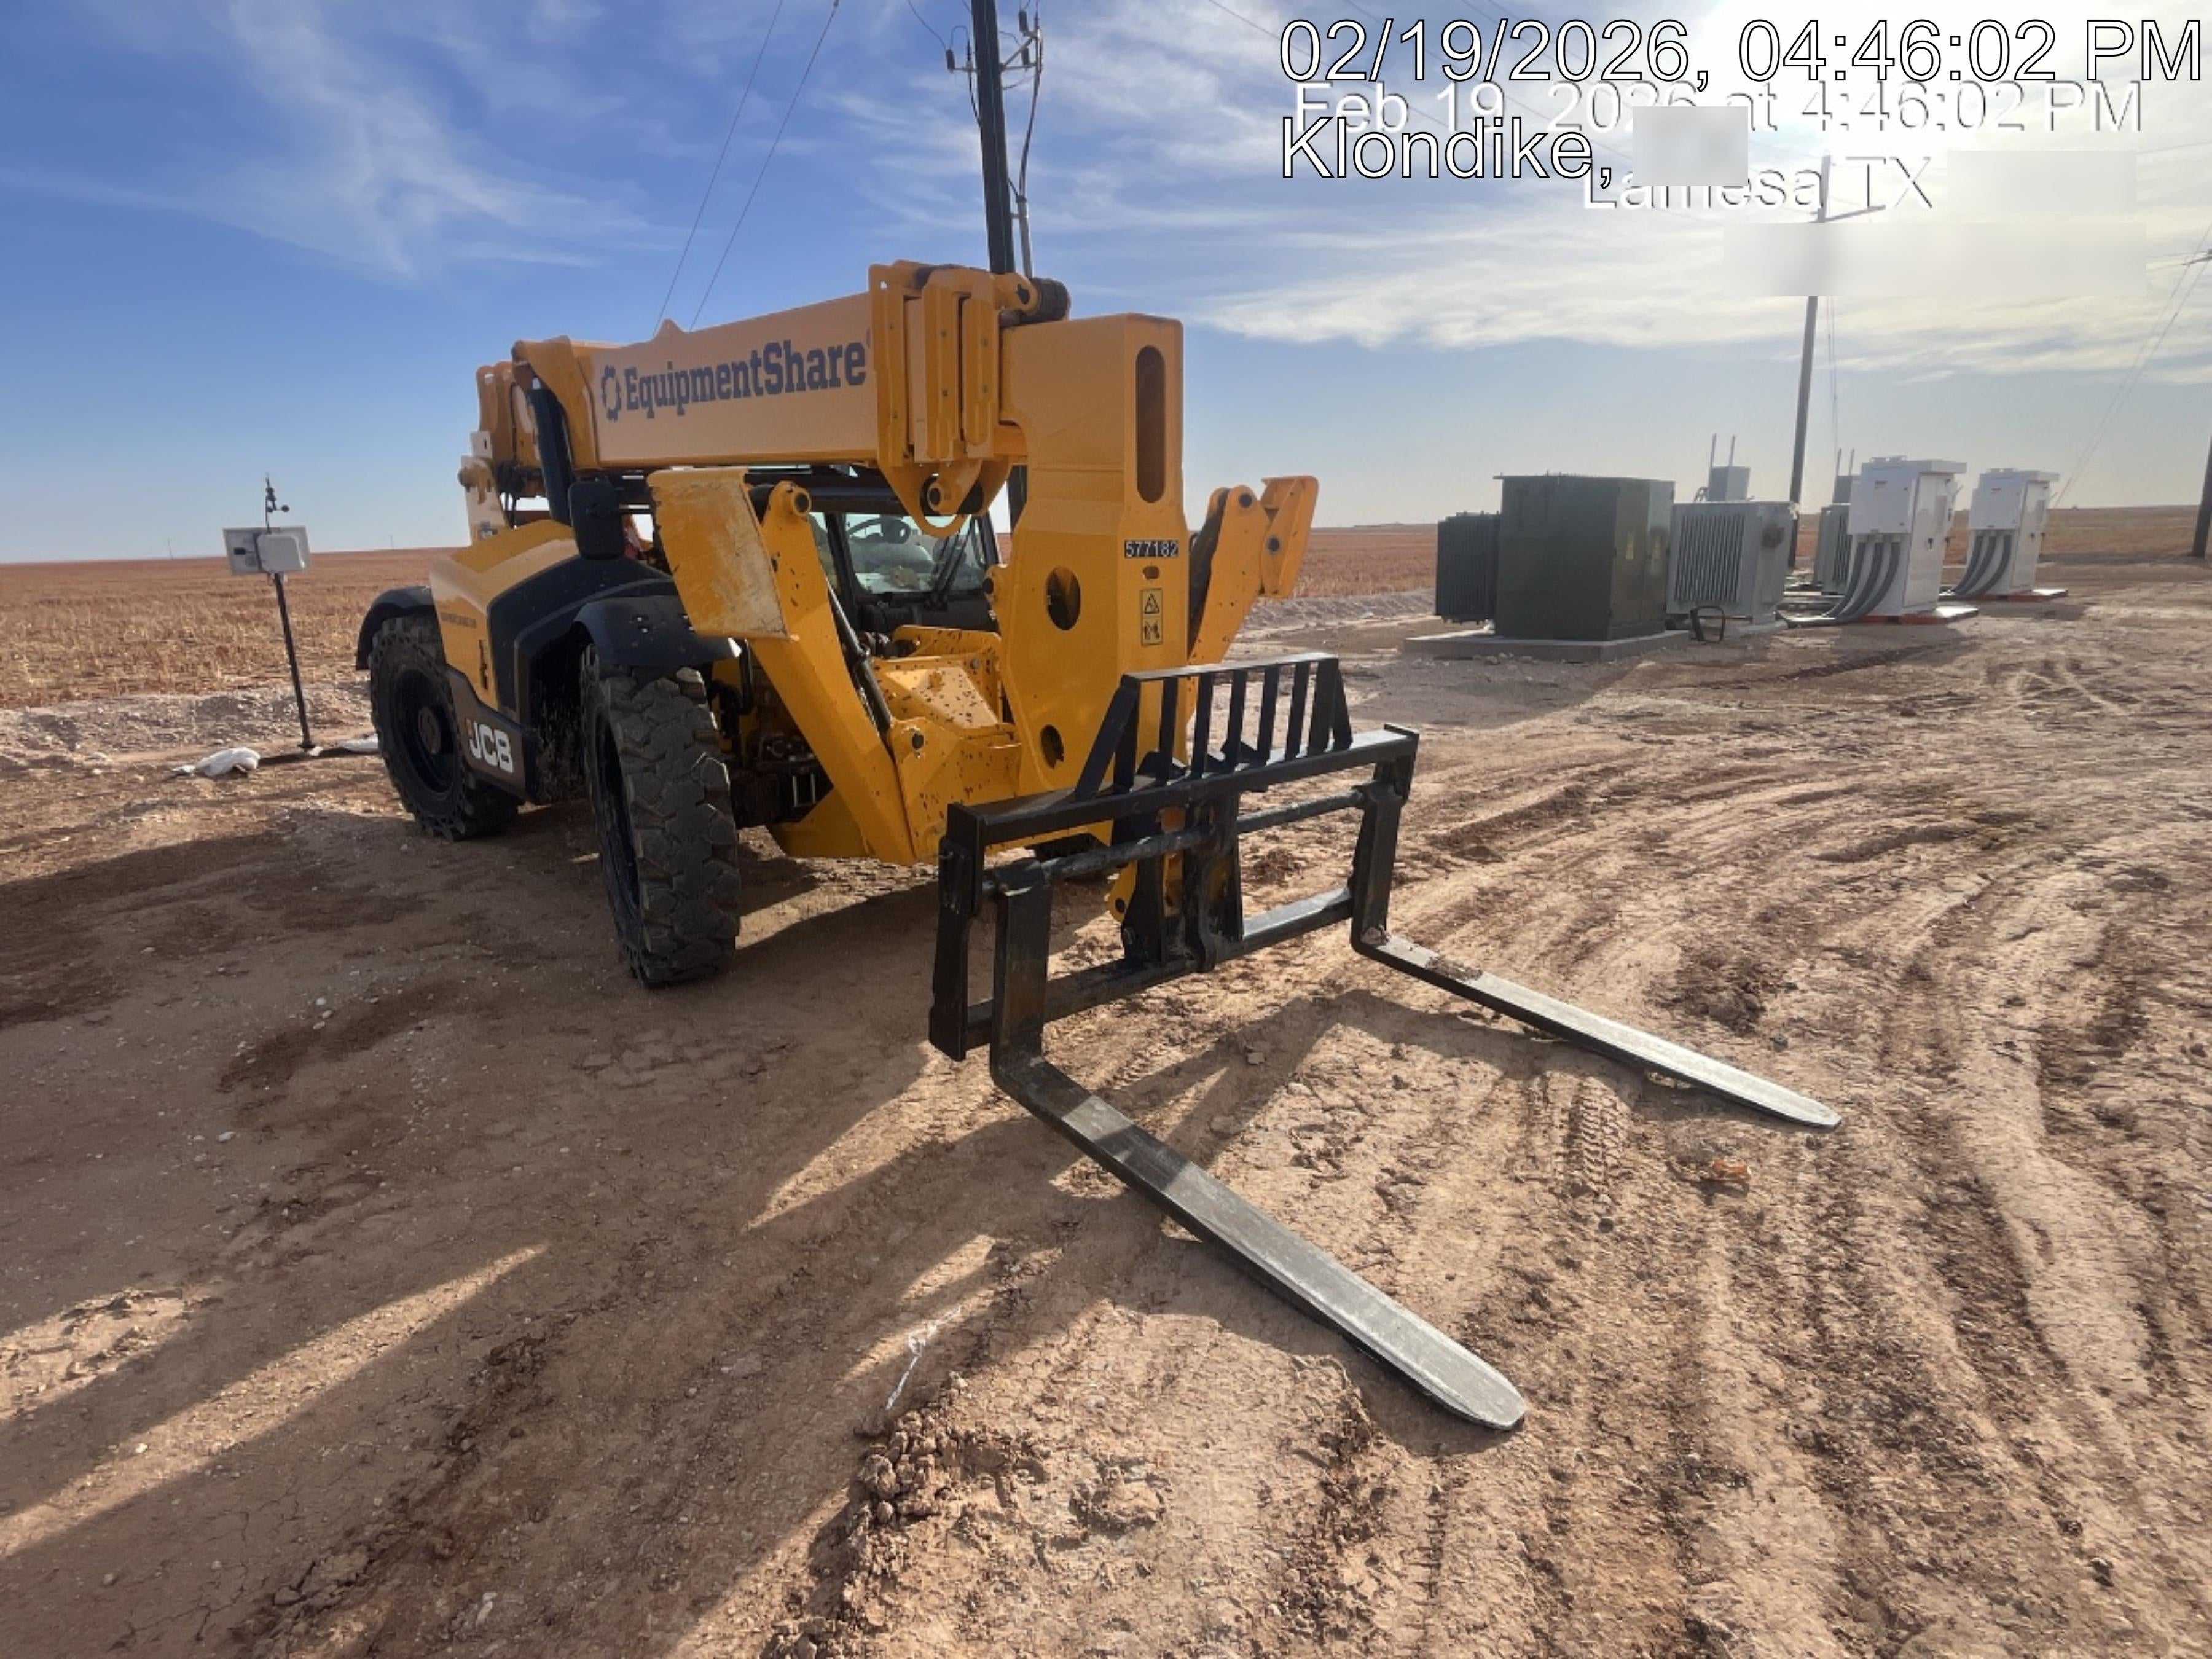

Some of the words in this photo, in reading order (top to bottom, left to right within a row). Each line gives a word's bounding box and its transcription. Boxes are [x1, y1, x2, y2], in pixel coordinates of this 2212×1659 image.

[624, 339, 866, 419] EquipmentShare
[1126, 541, 1178, 557] 577182
[469, 720, 514, 773] JCB
